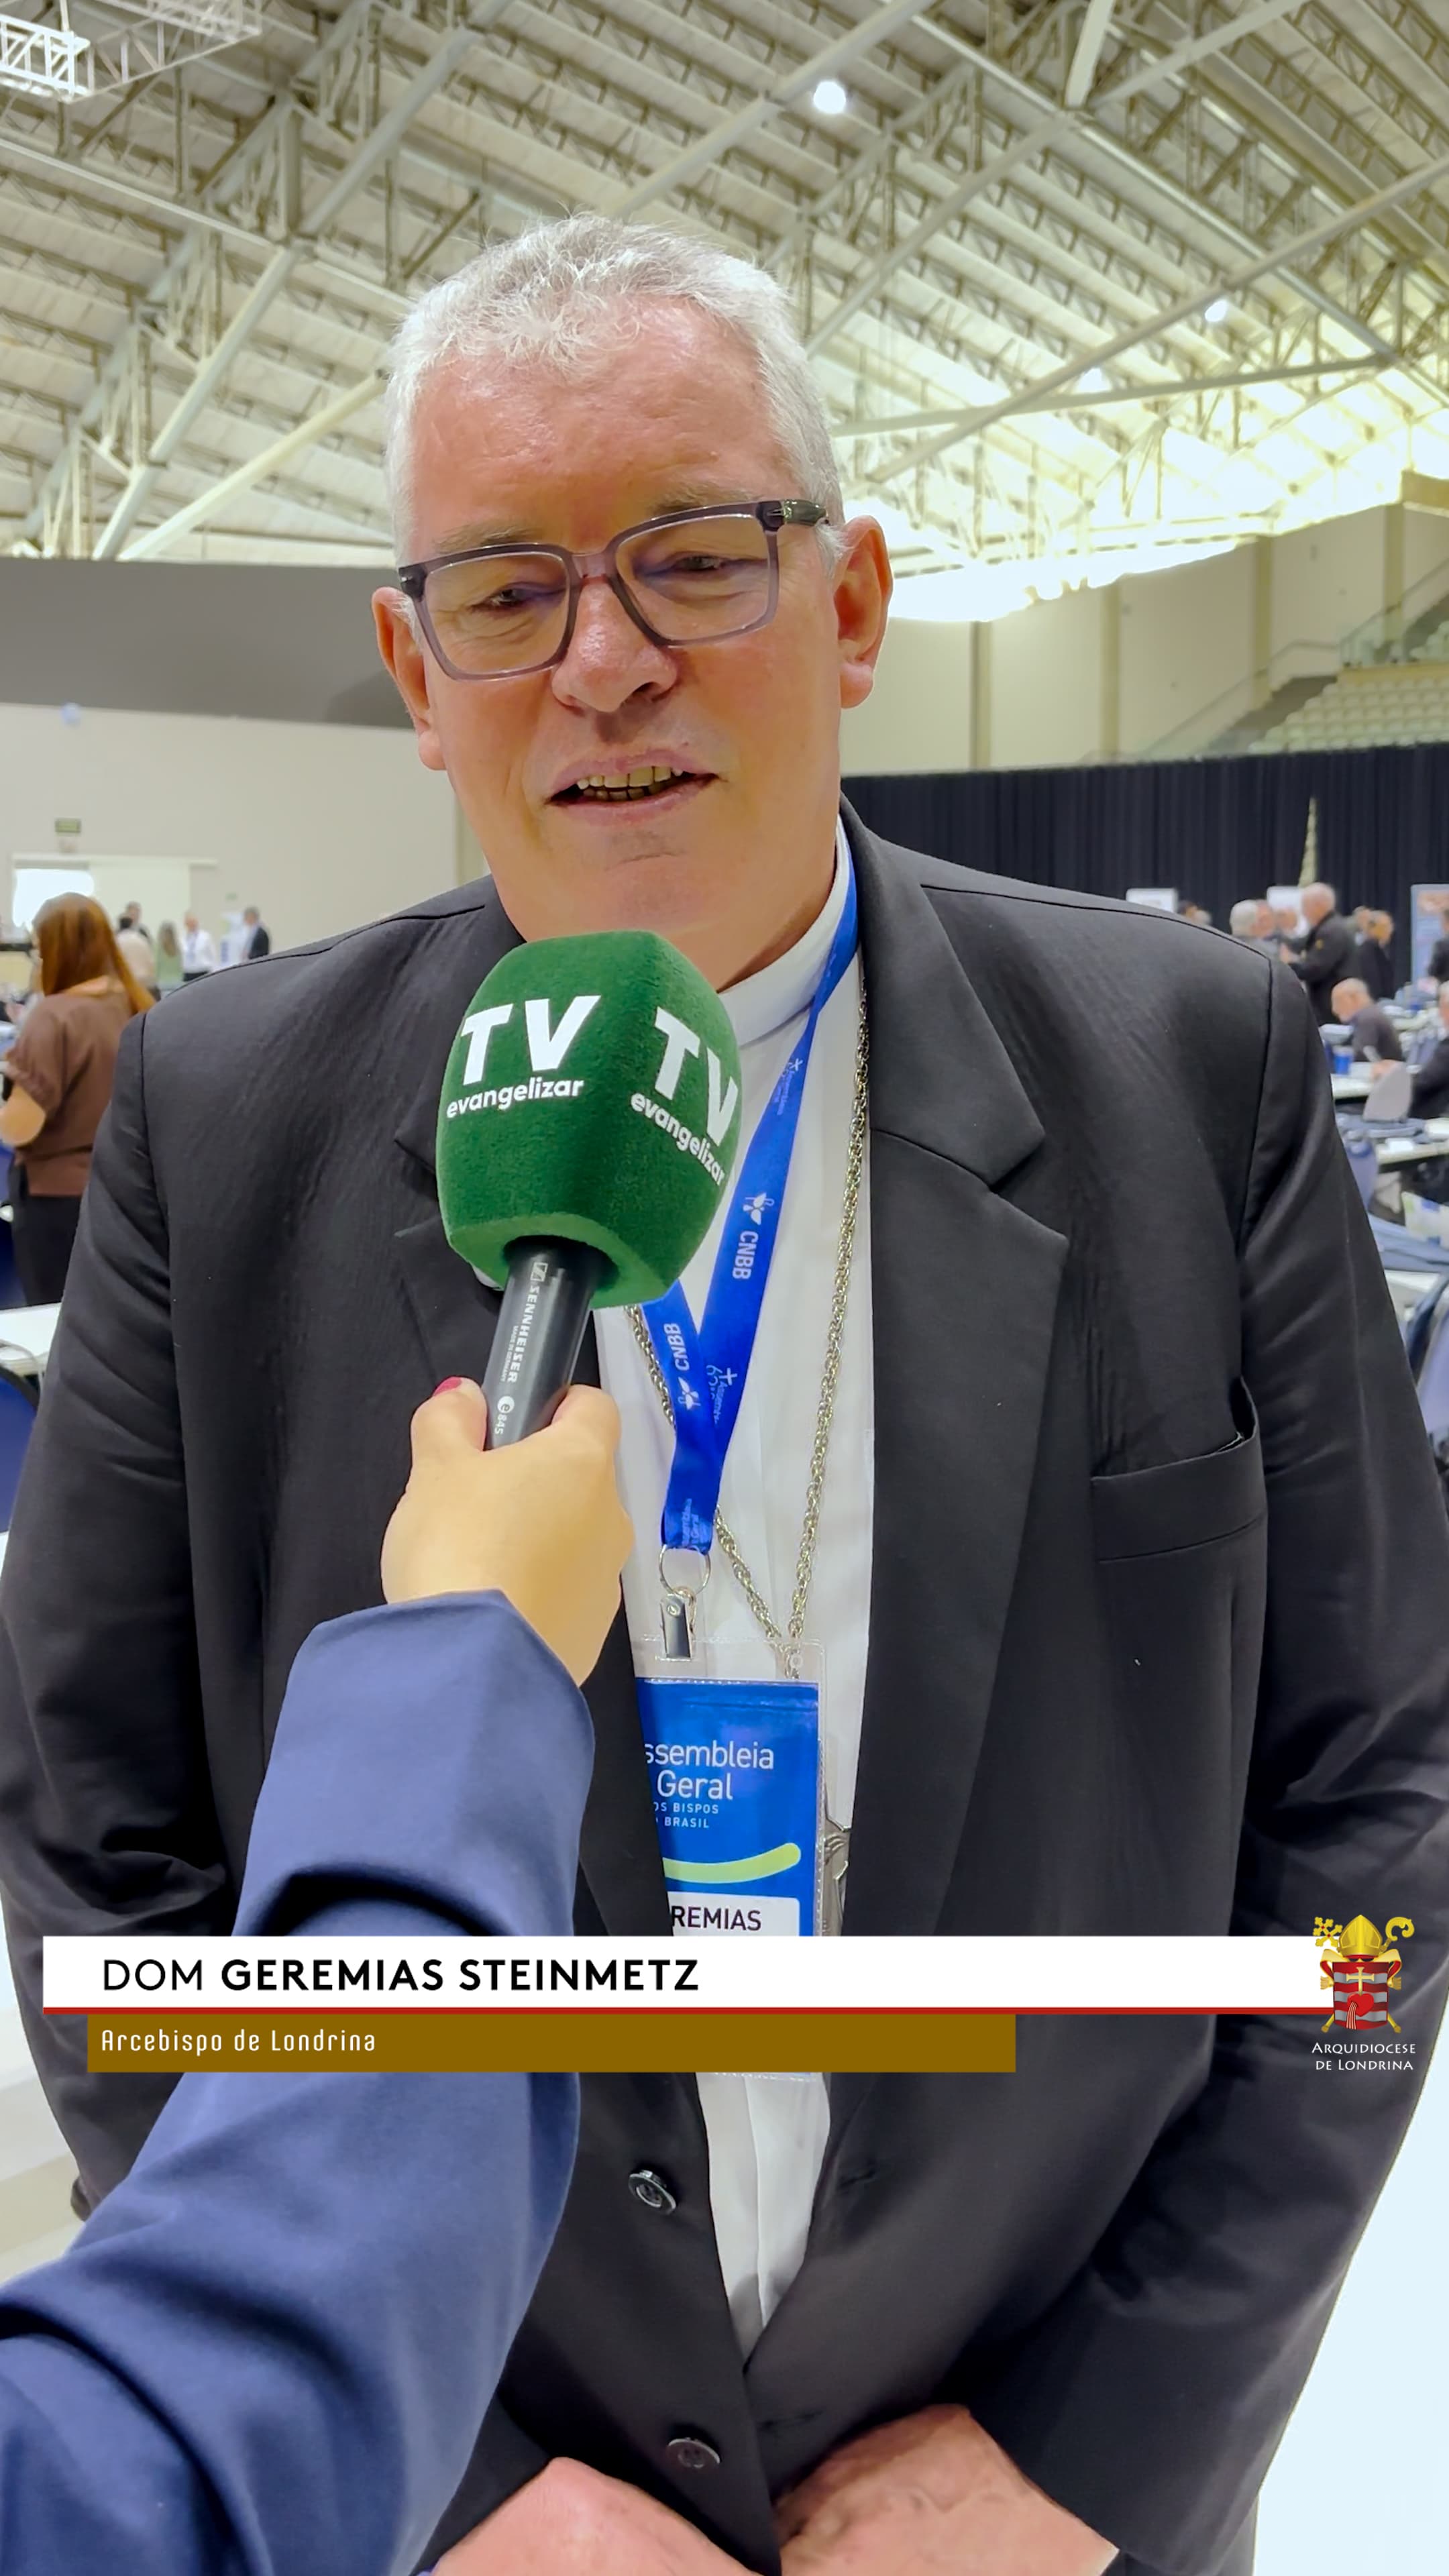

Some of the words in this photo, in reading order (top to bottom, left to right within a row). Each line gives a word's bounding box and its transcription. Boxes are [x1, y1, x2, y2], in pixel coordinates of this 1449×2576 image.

[460, 995, 602, 1087] TV
[446, 1077, 584, 1119] evangelizar
[654, 1006, 739, 1148] TV
[631, 1092, 725, 1187] evangelizar
[732, 1231, 759, 1279] CNBB
[507, 1285, 540, 1384] SENNHEISER
[663, 1322, 690, 1371] CNBB
[644, 1739, 774, 1770] ssembleia
[657, 1769, 734, 1801] Geral
[664, 1816, 709, 1829] BRASIL
[673, 1802, 719, 1815] BISPOS
[672, 1905, 761, 1932] REMIAS
